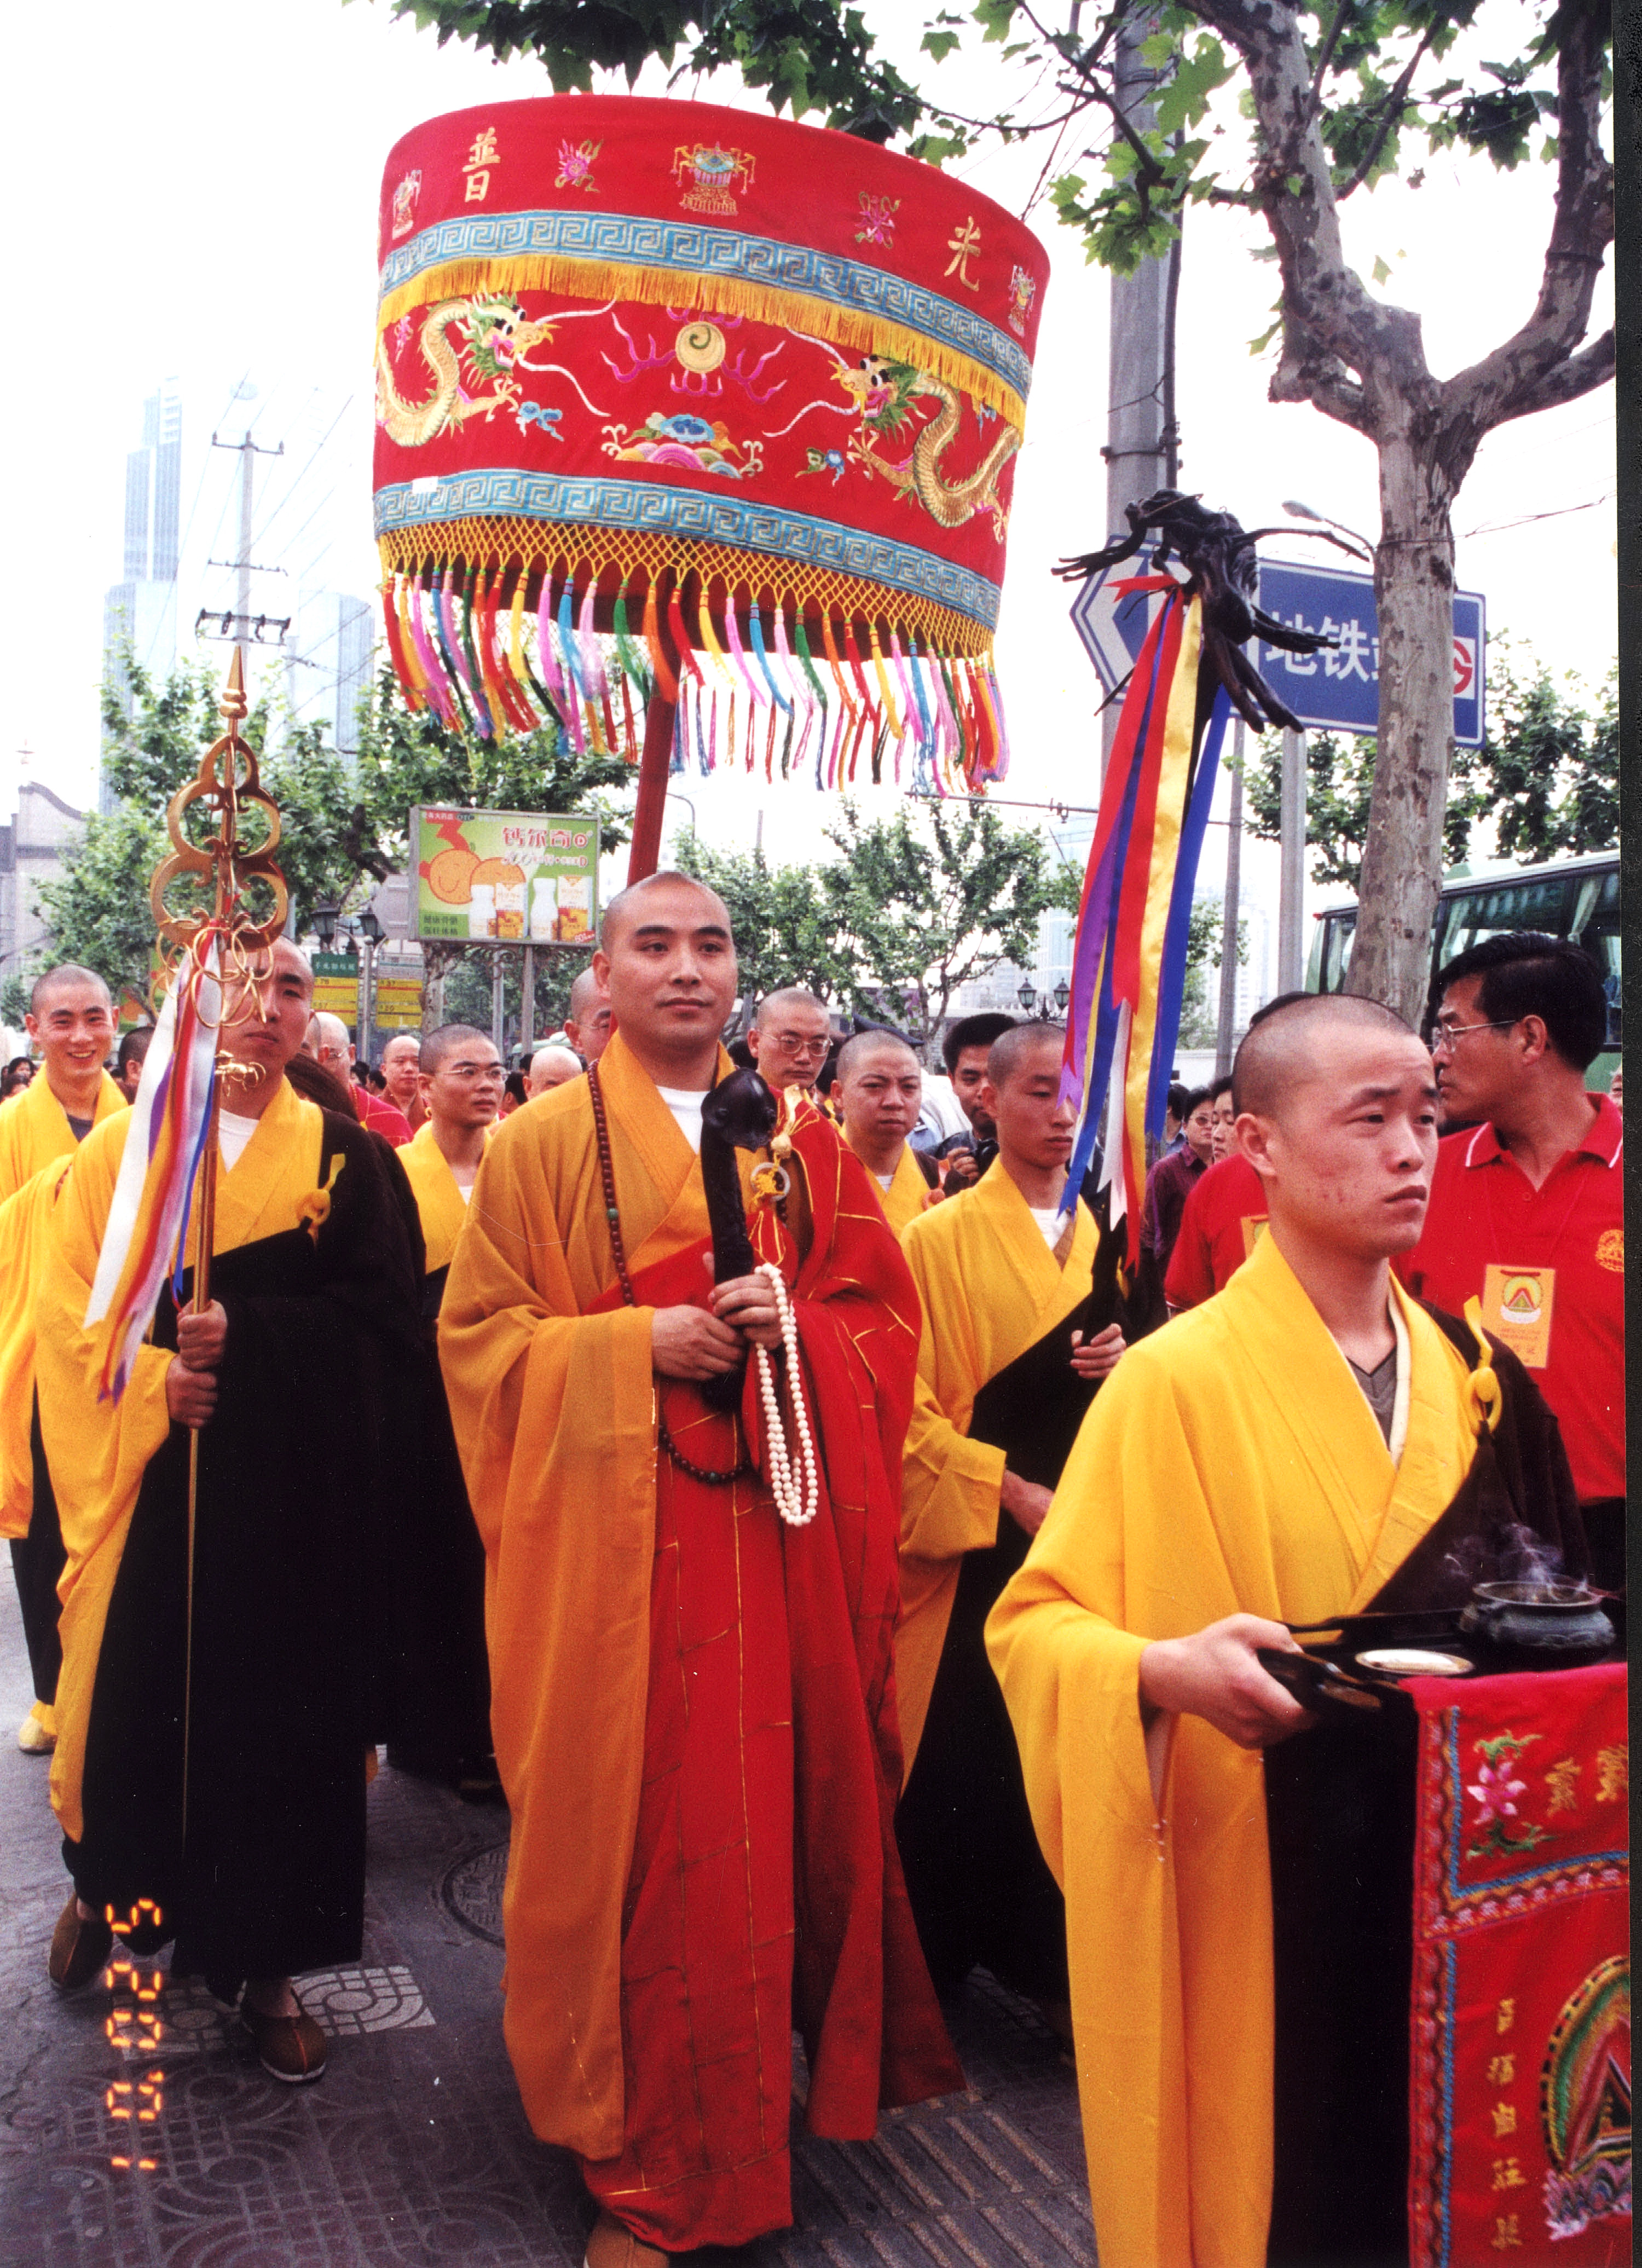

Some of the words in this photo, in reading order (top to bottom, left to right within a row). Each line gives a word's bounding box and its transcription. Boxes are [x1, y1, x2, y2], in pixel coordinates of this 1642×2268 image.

[462, 126, 501, 203] 普
[944, 215, 981, 292] 光
[1265, 611, 1379, 682] 地铁
